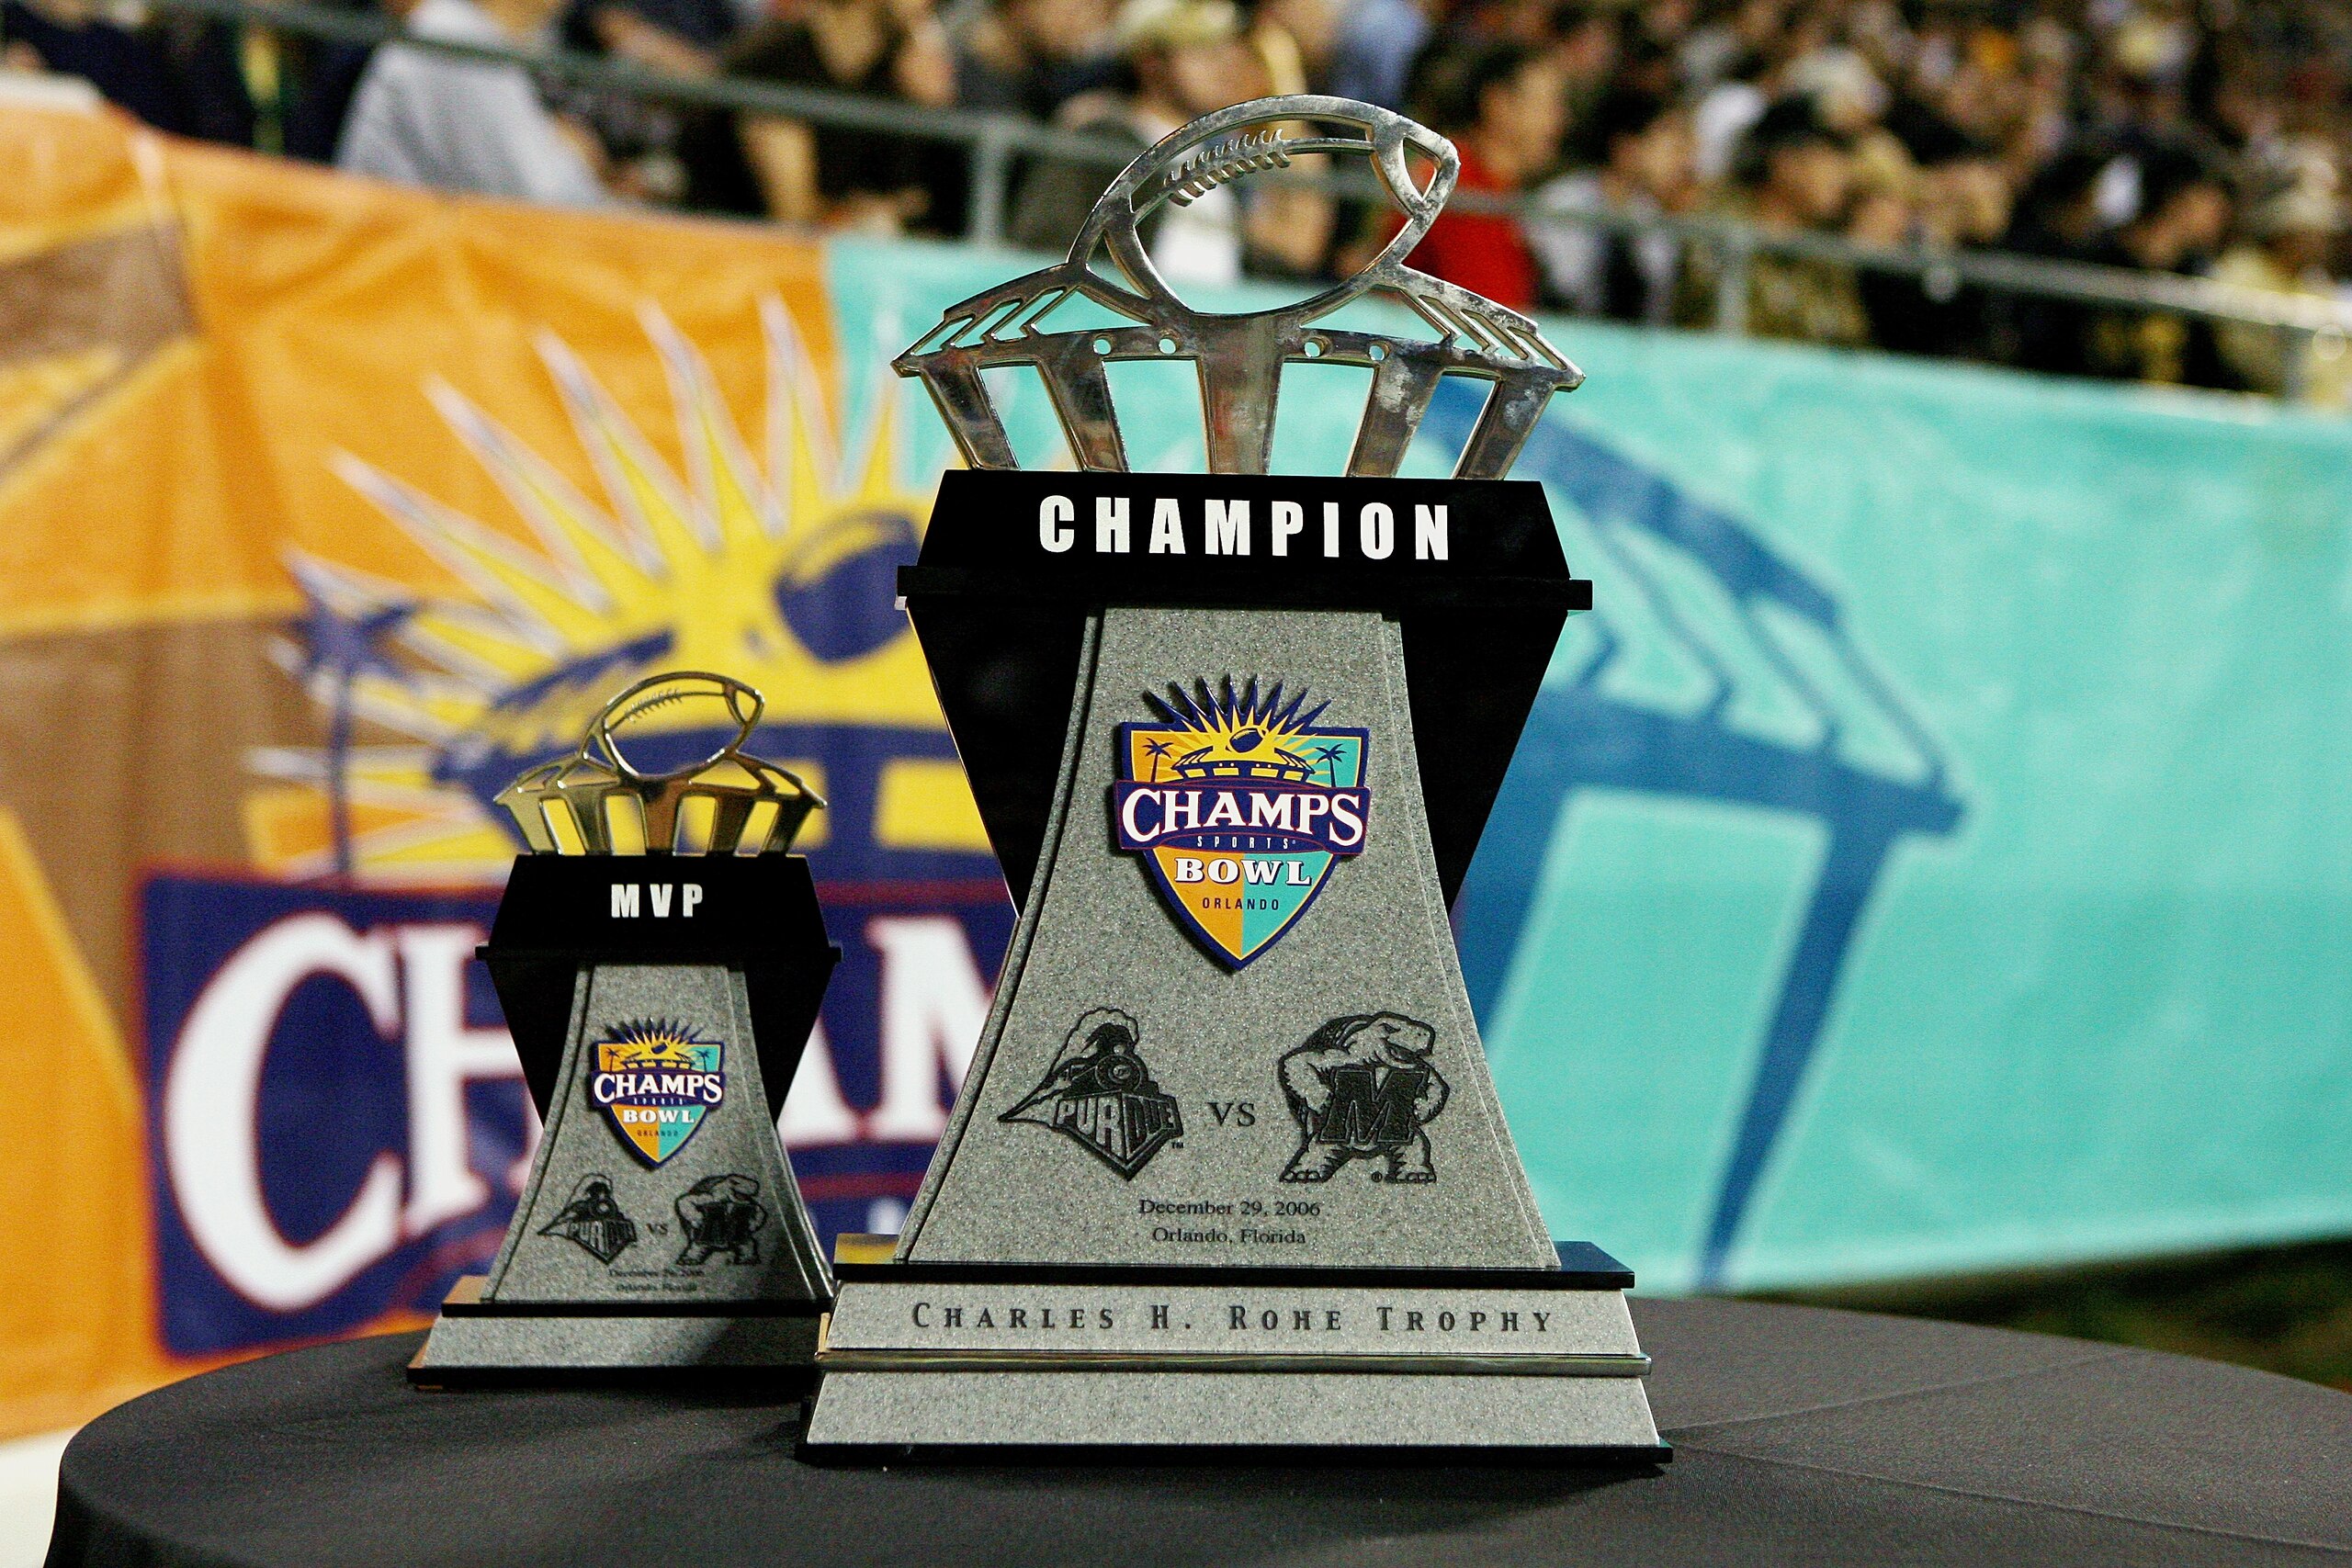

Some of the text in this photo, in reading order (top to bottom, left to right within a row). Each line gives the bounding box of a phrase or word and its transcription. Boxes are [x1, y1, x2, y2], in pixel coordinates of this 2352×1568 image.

[1038, 494, 1449, 561] CHAMPION
[1121, 788, 1363, 847] CHAMPS
[1196, 835, 1289, 850] SPORTS
[1174, 857, 1312, 886] BOWL
[610, 883, 704, 919] MVP
[1202, 897, 1280, 911] ORLANDO
[594, 1073, 723, 1103] CHAMPS
[622, 1109, 695, 1123] BOWL
[1055, 1091, 1176, 1157] PURDUE
[1206, 1101, 1257, 1127] VS
[1137, 1199, 1321, 1217] December 29, 2006
[1151, 1226, 1306, 1245] Orlando, Florida
[911, 1302, 1552, 1332] CHARLES H. ROHE TROPHY
